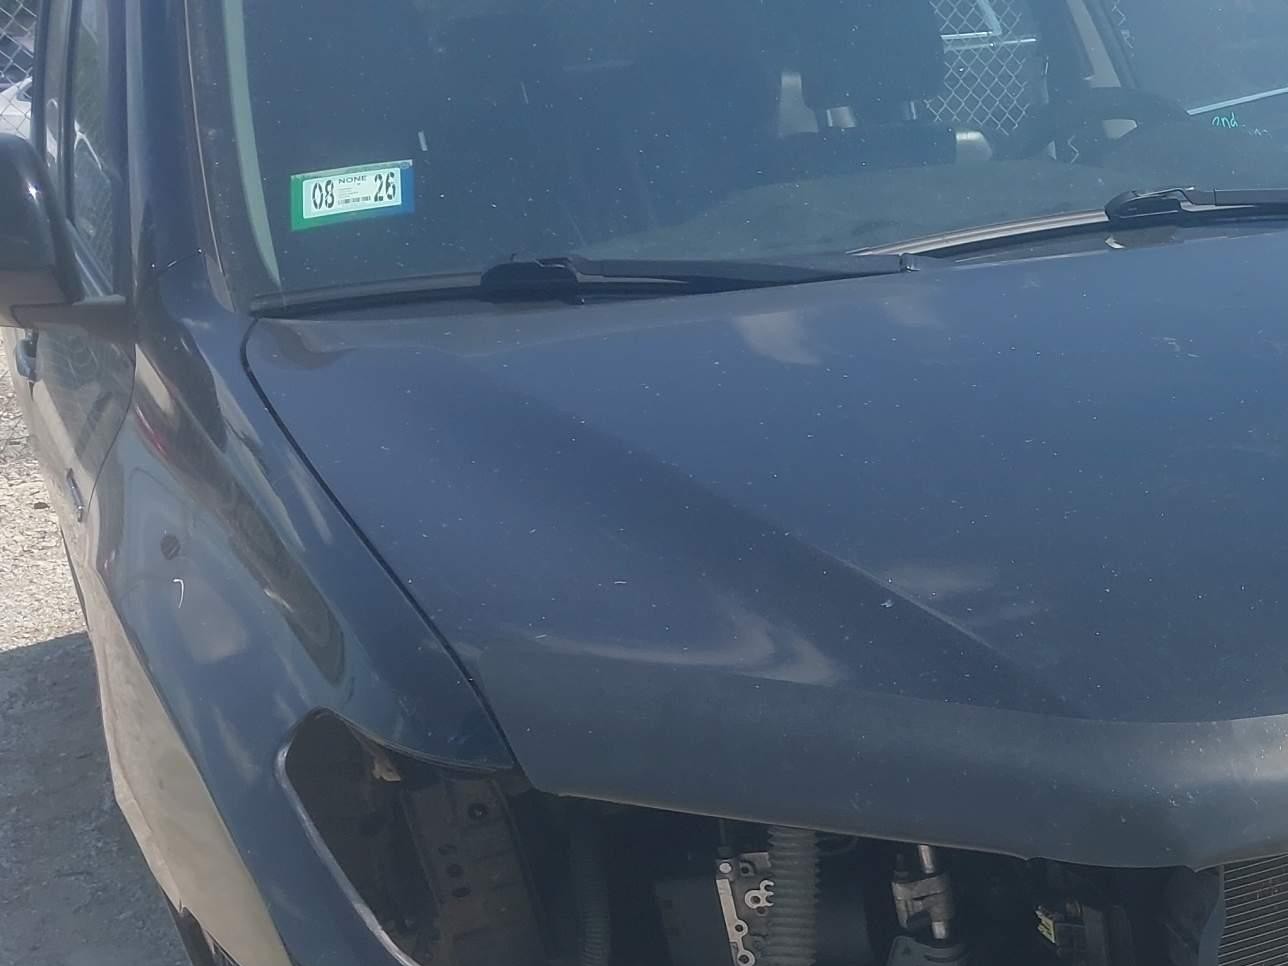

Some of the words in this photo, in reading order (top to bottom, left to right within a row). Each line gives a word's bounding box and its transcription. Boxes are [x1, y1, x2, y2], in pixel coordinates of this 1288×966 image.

[311, 179, 335, 210] 08
[373, 171, 396, 202] 26
[338, 175, 367, 184] NONE
